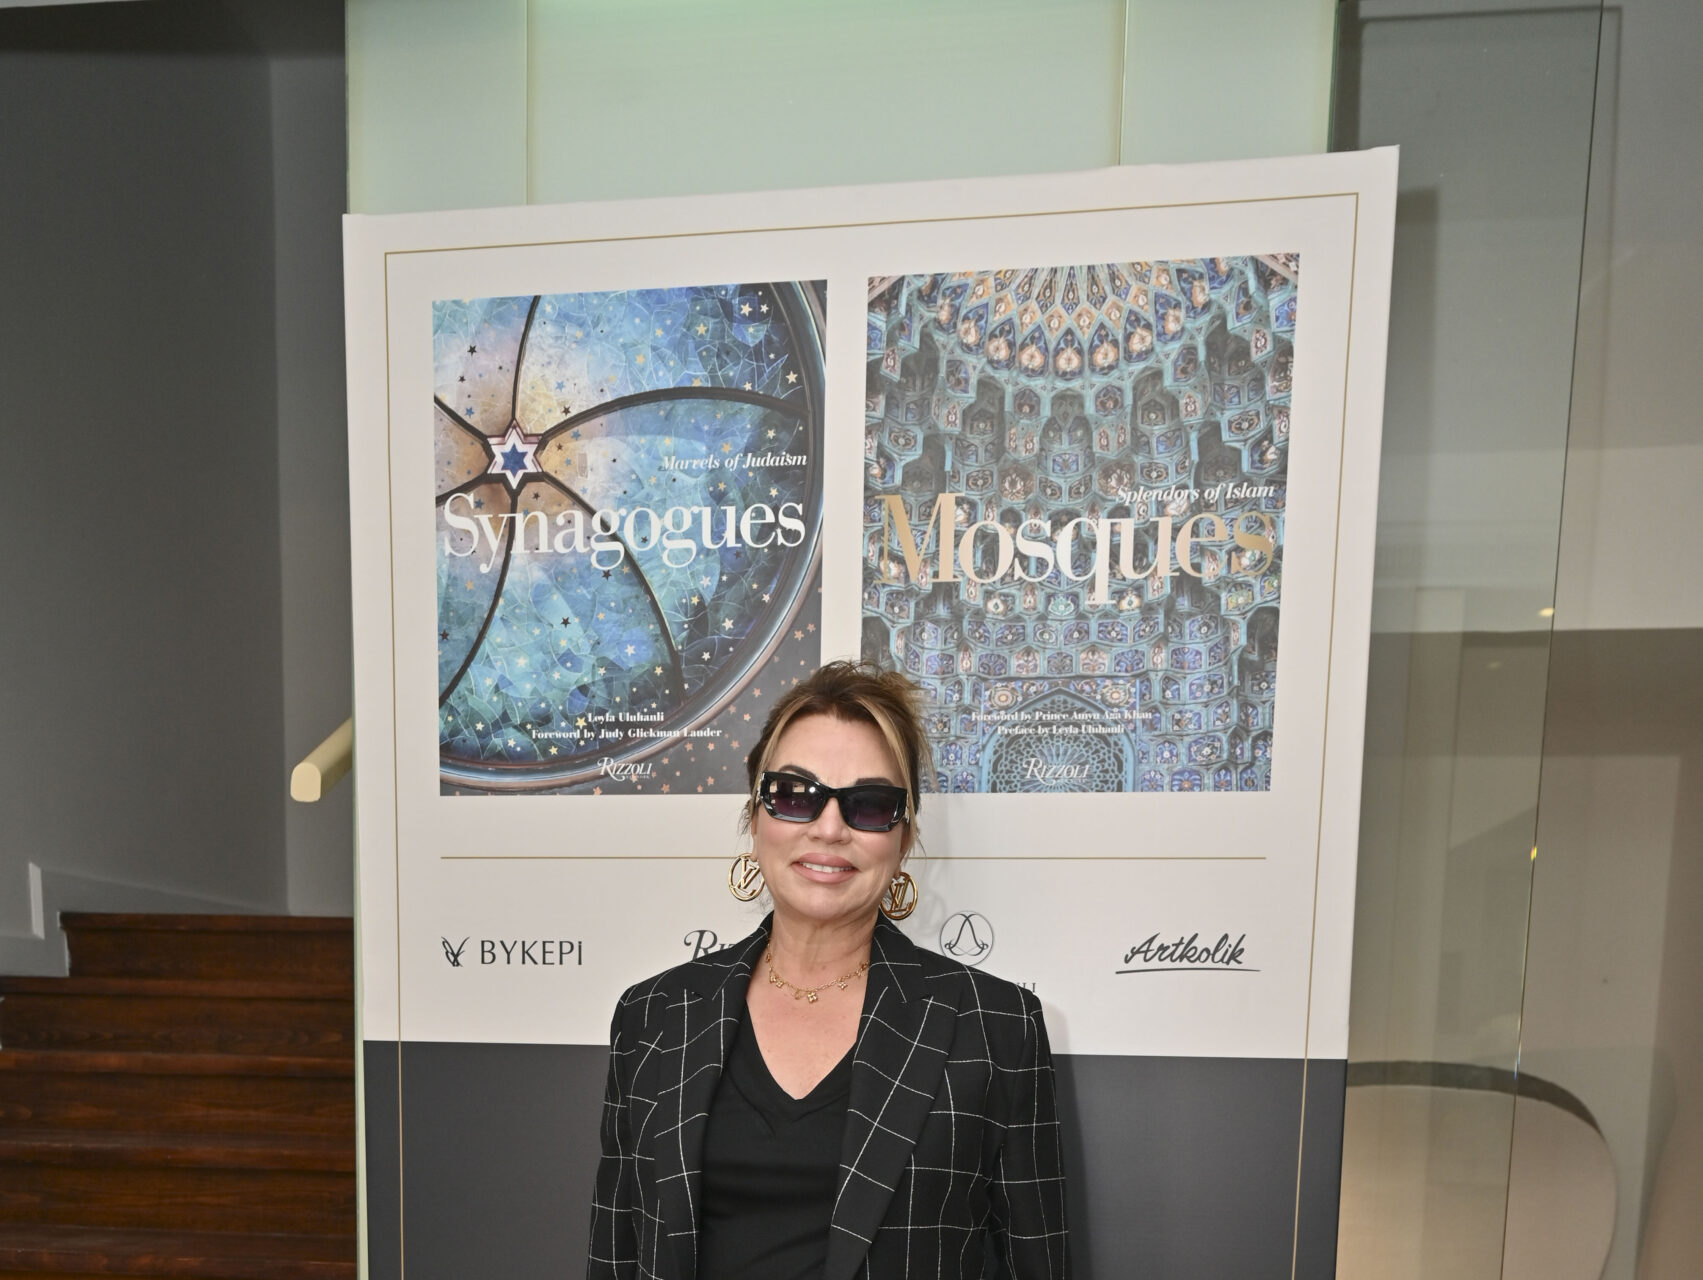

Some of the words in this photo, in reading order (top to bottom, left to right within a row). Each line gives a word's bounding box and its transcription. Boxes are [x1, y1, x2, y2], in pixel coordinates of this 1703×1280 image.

[662, 454, 720, 470] Marvels
[724, 453, 743, 471] of
[743, 451, 808, 469] Judaism
[1117, 485, 1200, 505] Splendors
[1204, 483, 1226, 503] of
[1225, 482, 1275, 499] Islam
[444, 493, 806, 574] Synagogues
[874, 492, 1275, 605] Mosques
[619, 711, 665, 722] Uluhanli
[972, 711, 1018, 721] Foreword
[1021, 711, 1032, 722] by
[1035, 711, 1069, 720] Prince
[1124, 710, 1152, 719] Khan
[532, 729, 581, 739] Foreword
[584, 729, 596, 741] by
[599, 728, 625, 740] Judy
[628, 728, 680, 738] Glickman
[998, 725, 1035, 734] Preface
[1038, 725, 1049, 736] by
[1052, 725, 1079, 736] Leyla
[1124, 932, 1246, 965] Artkolik
